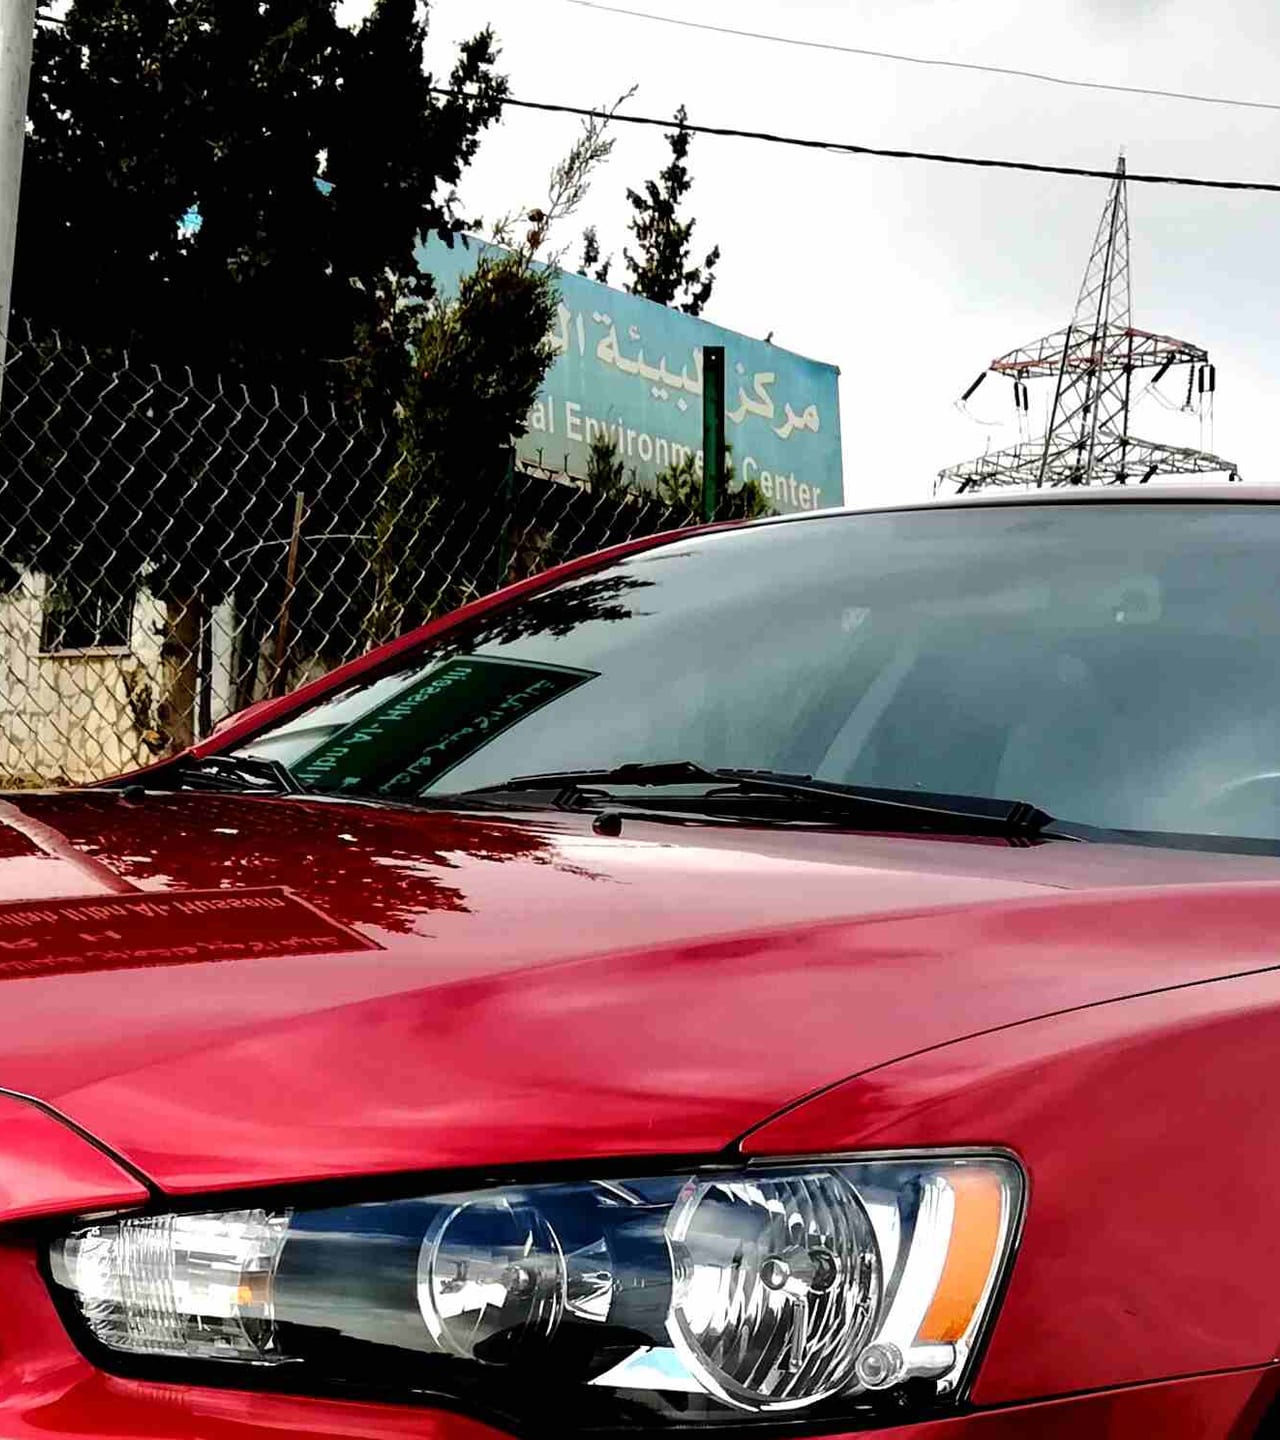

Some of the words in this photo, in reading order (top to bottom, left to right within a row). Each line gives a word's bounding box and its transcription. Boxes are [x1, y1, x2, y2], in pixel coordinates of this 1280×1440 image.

[592, 311, 704, 412] لبيئة
[725, 361, 820, 439] مركز
[566, 401, 732, 481] Environme
[742, 456, 821, 510] Center
